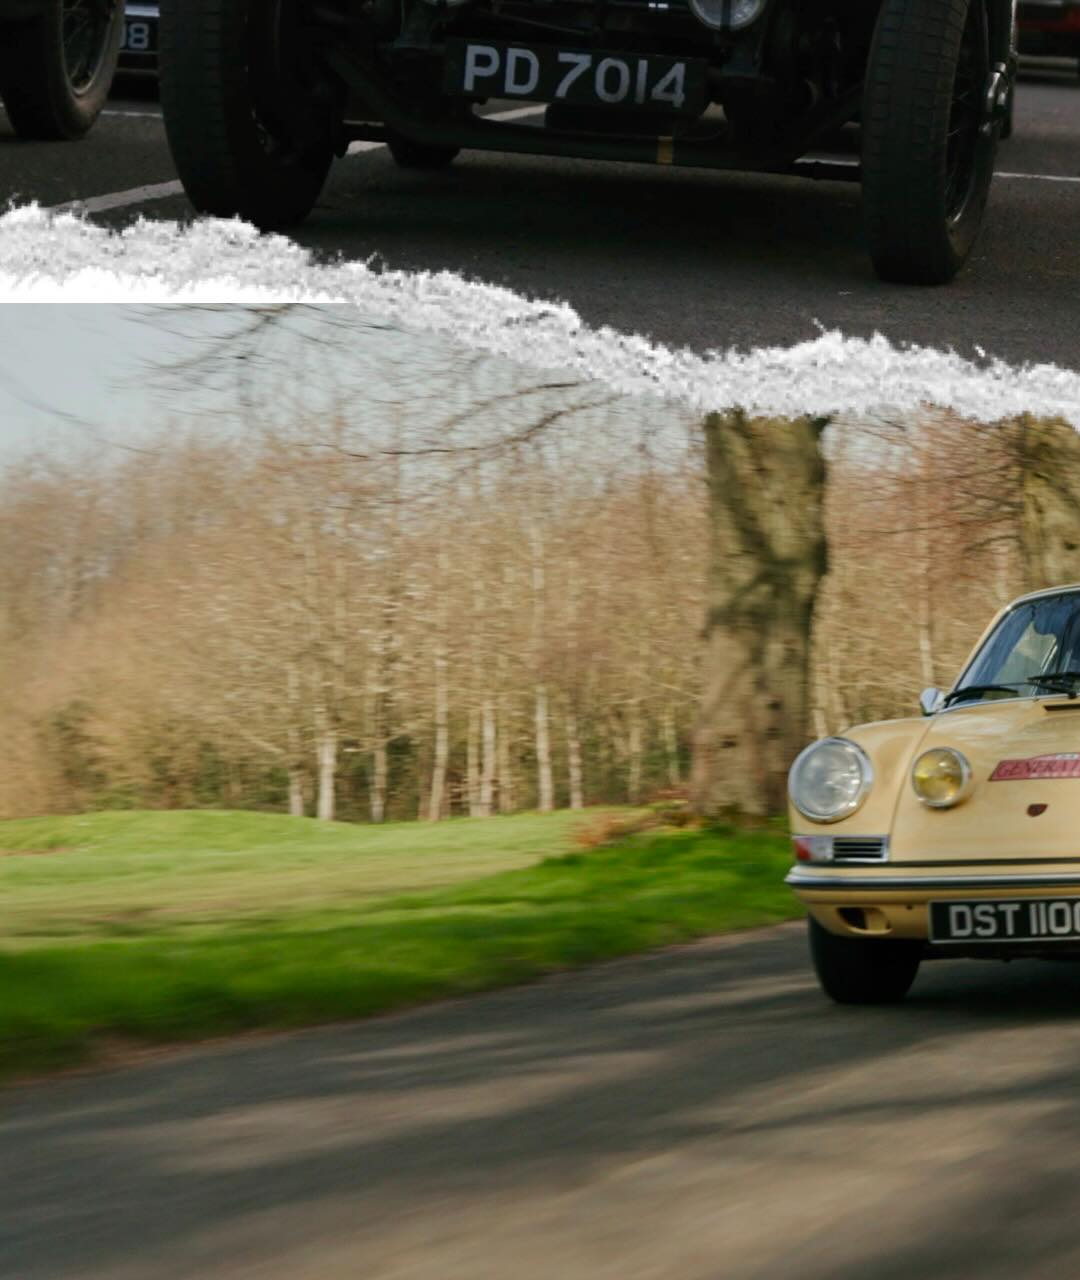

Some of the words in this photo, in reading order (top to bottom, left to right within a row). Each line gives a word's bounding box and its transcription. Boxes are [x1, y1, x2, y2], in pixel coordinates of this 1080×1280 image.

[463, 44, 540, 96] PD
[554, 51, 686, 109] 7014
[950, 903, 1021, 937] DST
